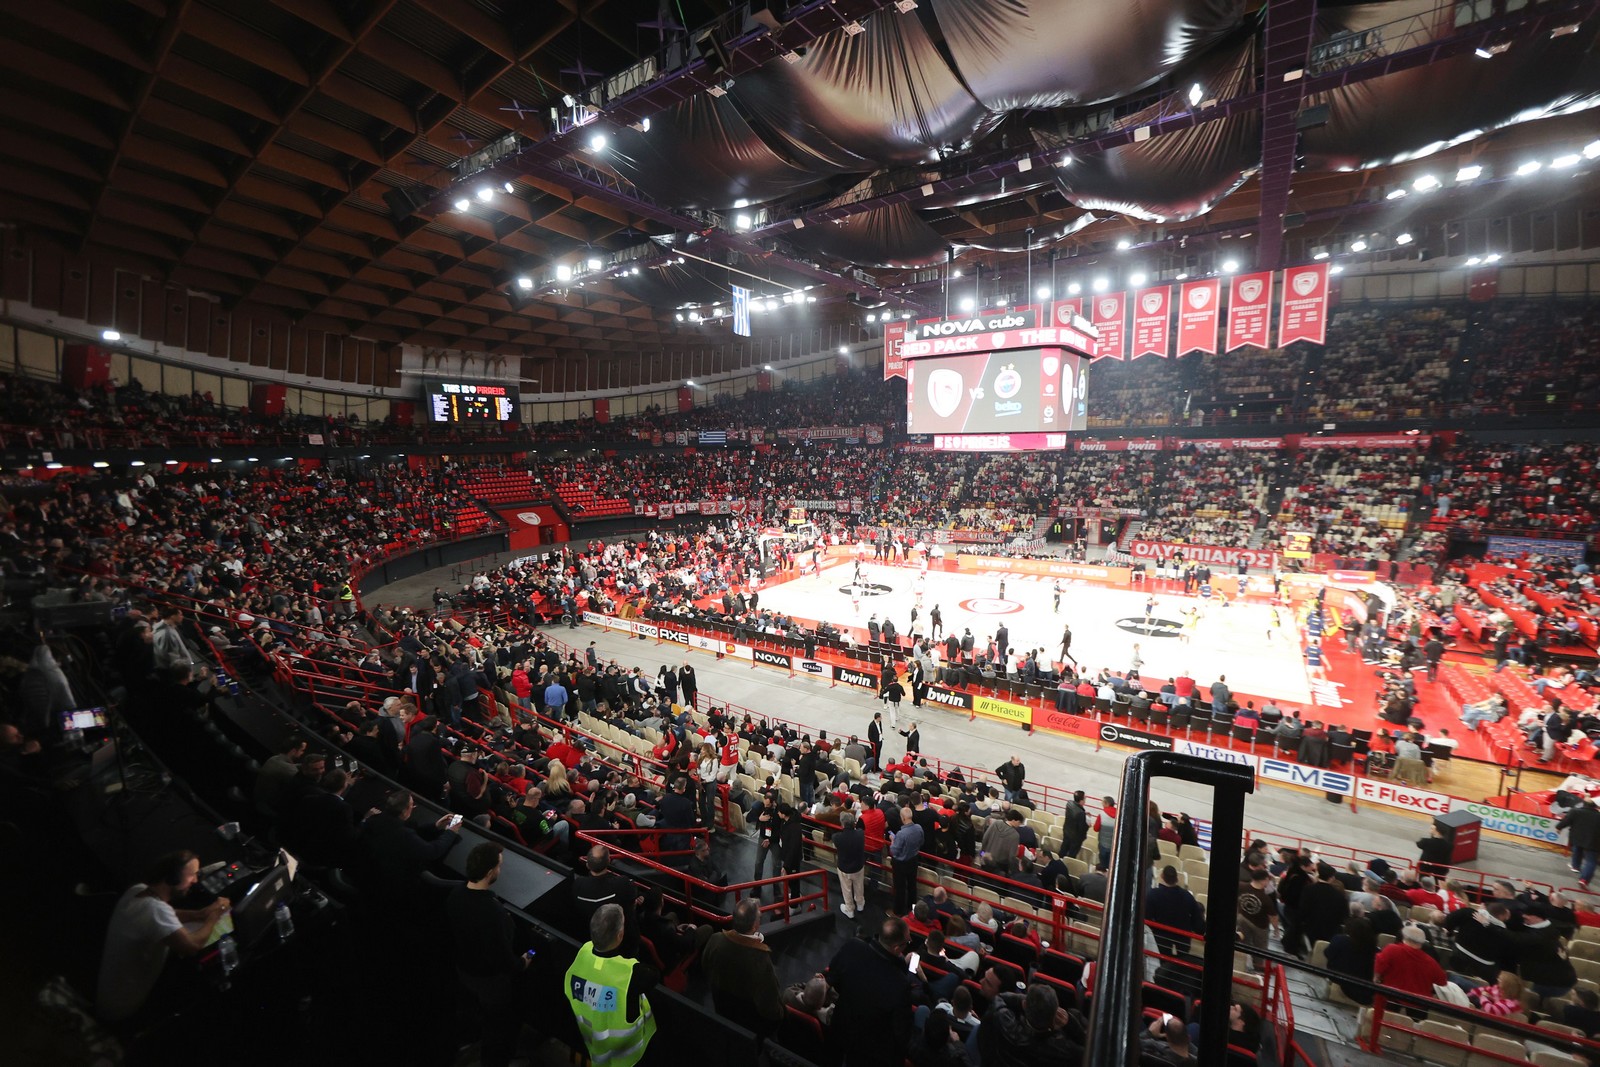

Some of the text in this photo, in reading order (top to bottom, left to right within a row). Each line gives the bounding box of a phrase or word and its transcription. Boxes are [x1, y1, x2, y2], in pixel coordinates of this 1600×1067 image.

[924, 315, 1025, 337] NOVA cube
[1020, 329, 1056, 344] THE
[902, 336, 978, 356] RED PACK
[969, 388, 984, 399] VS
[1080, 442, 1106, 450] bwin
[1127, 441, 1156, 450] bwin
[1241, 440, 1280, 448] FlexCar
[810, 500, 836, 510] SICKNESS
[1050, 565, 1108, 577] MATTERS
[640, 626, 657, 636] EKO
[660, 628, 688, 644] AXE
[755, 652, 788, 666] NOVA
[990, 703, 1025, 718] Piraeus
[1120, 733, 1148, 744] NEVER
[1150, 740, 1172, 748] QUIT
[1264, 760, 1350, 792] FMS
[1467, 804, 1551, 828] COSMOTE
[1481, 818, 1559, 841] urance
